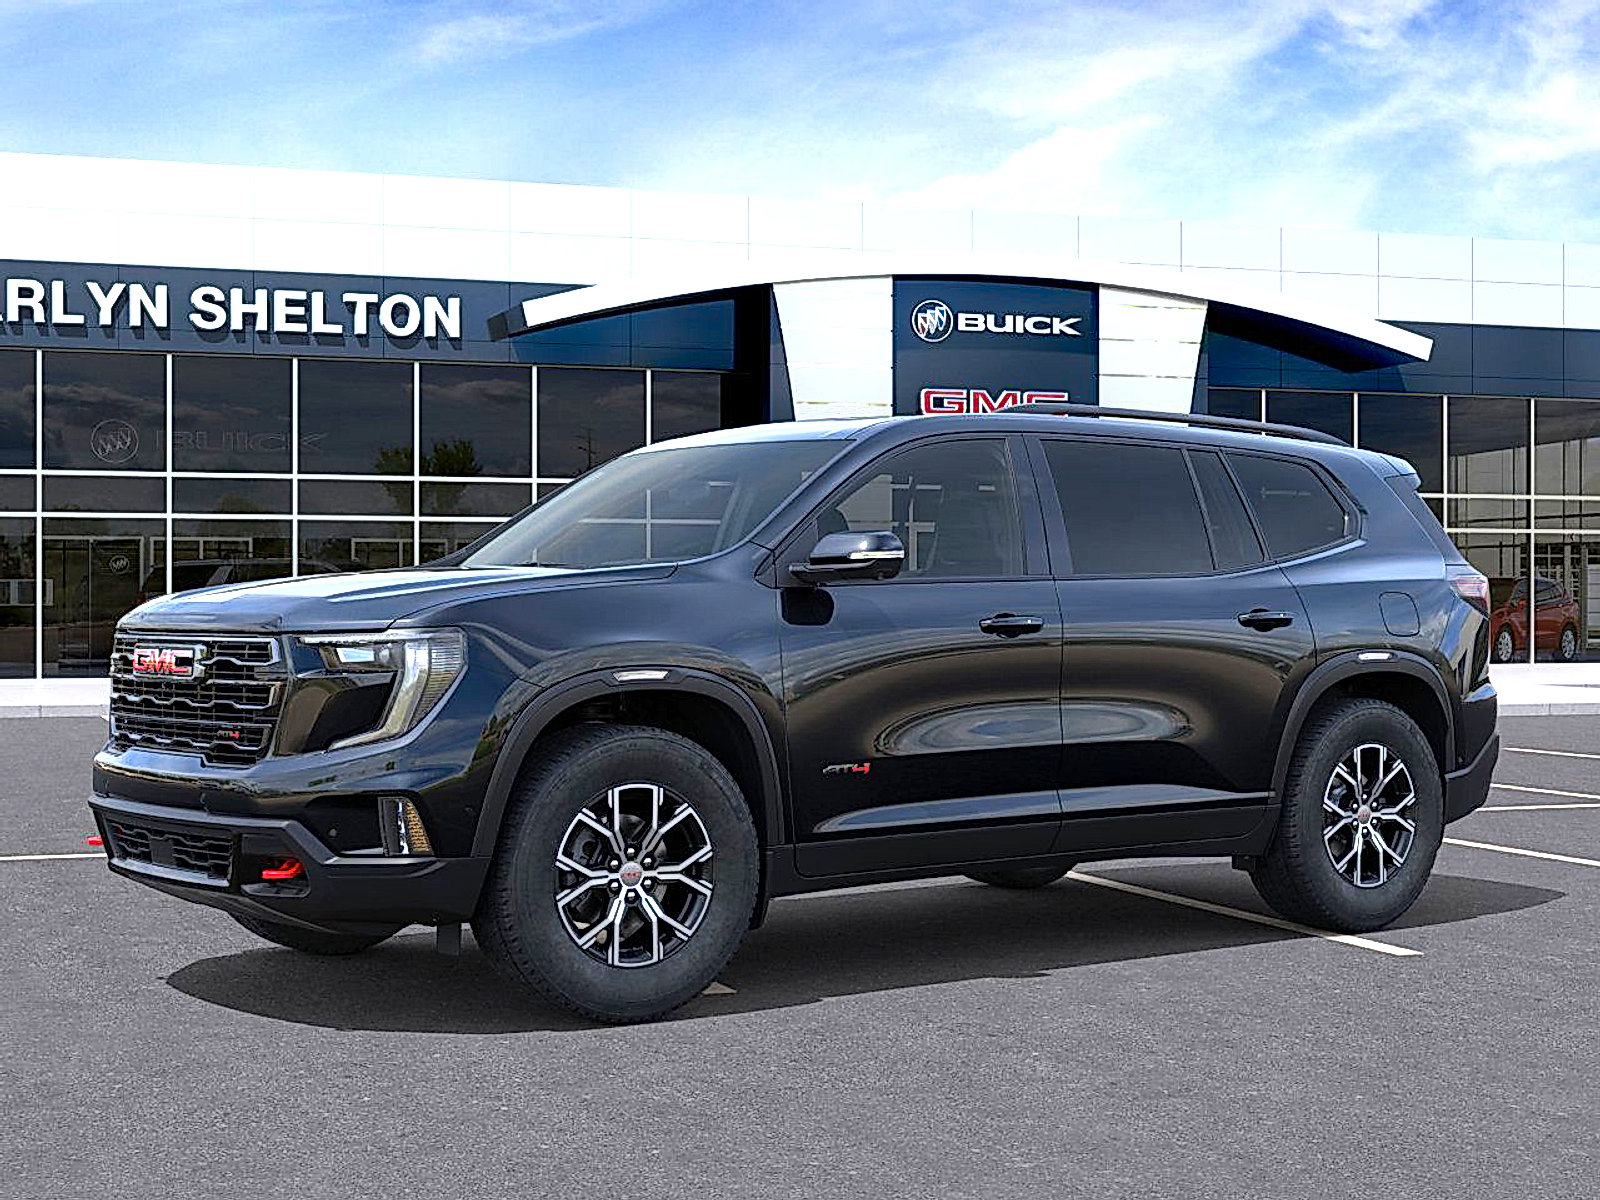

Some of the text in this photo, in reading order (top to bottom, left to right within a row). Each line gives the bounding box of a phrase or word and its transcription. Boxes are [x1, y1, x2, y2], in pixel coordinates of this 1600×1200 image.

[0, 278, 461, 338] RLYN SHELTON
[957, 312, 1083, 336] BUICK
[133, 648, 195, 675] GMC
